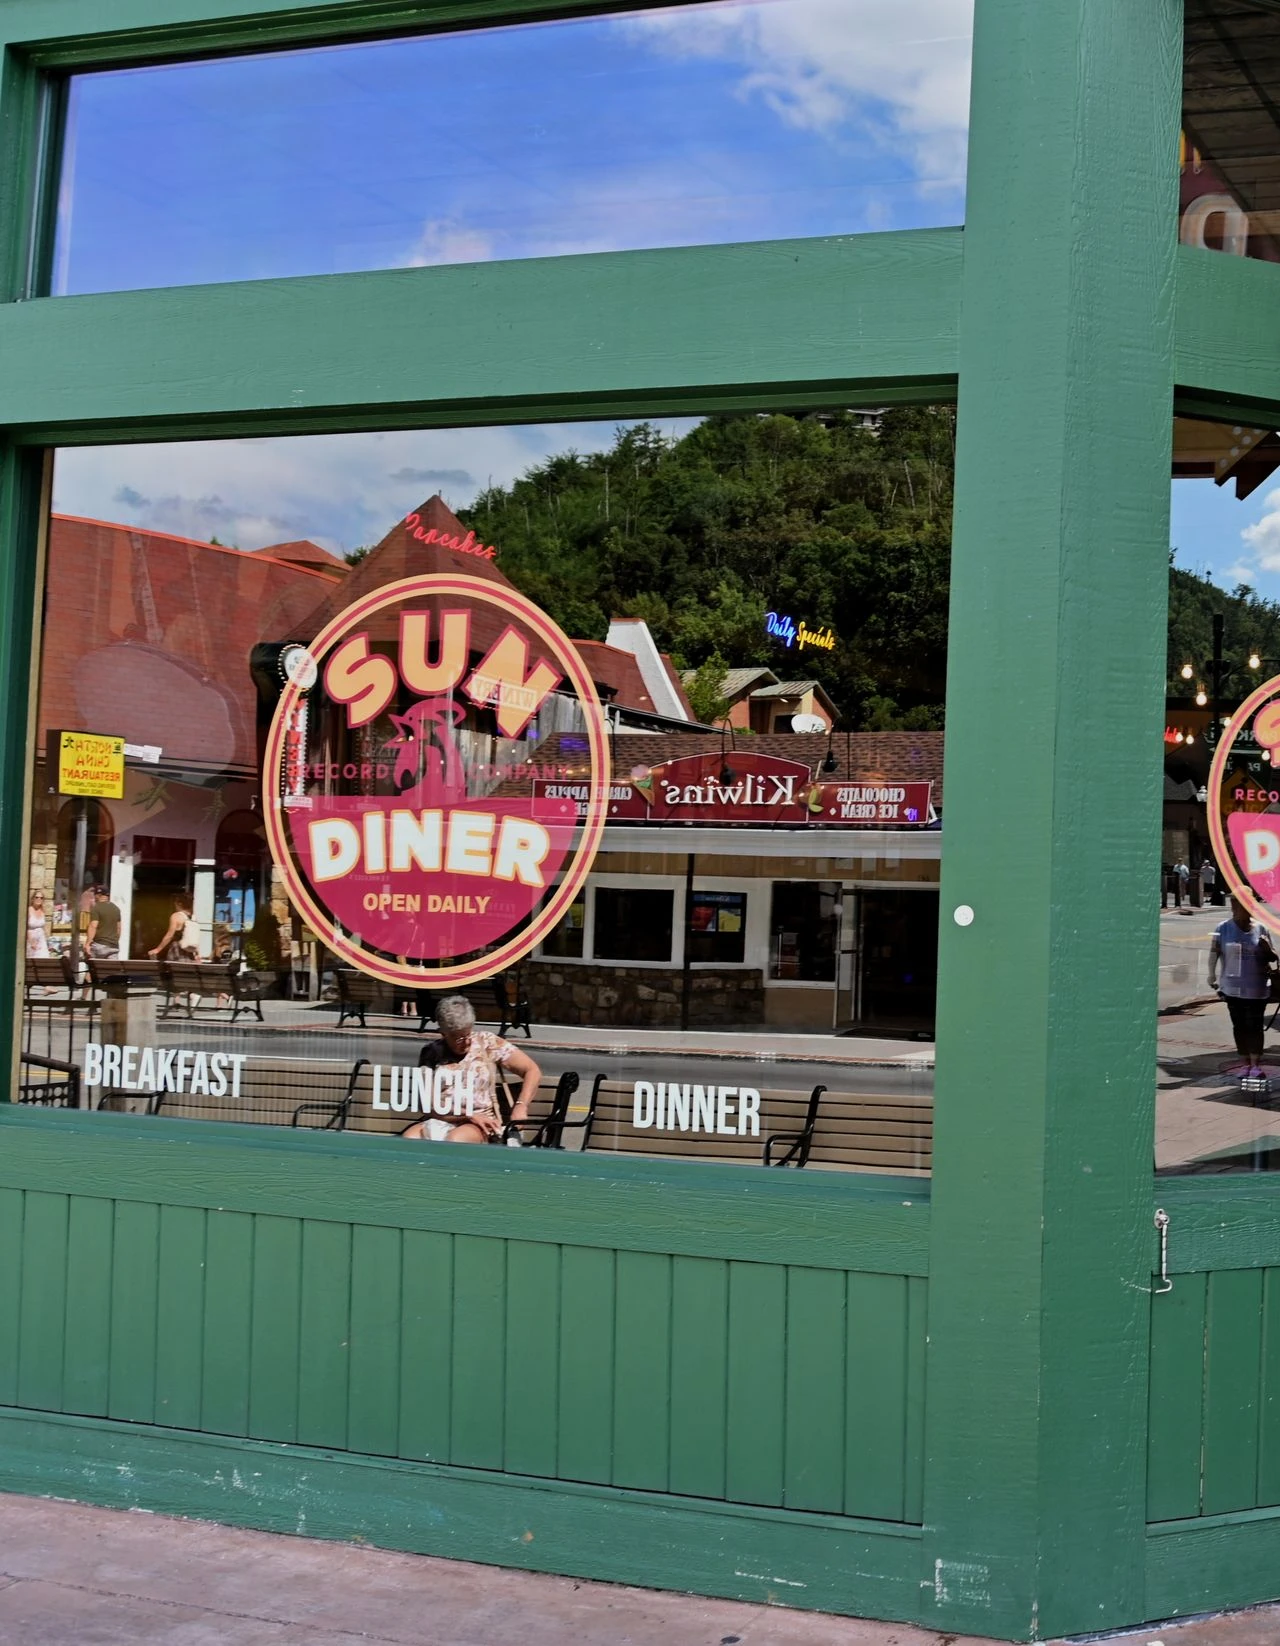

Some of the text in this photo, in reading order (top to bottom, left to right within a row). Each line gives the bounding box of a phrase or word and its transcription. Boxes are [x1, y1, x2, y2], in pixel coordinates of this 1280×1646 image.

[764, 611, 836, 650] Daily Specials
[323, 608, 563, 739] SUN
[298, 763, 389, 779] RECORD
[468, 763, 570, 780] COMPANY
[307, 808, 550, 888] DINER
[363, 892, 421, 913] OPEN
[426, 894, 490, 915] DAILY
[84, 1043, 248, 1098] BREAKFAST
[372, 1065, 475, 1117] LUNCH
[632, 1080, 761, 1137] DINNER
